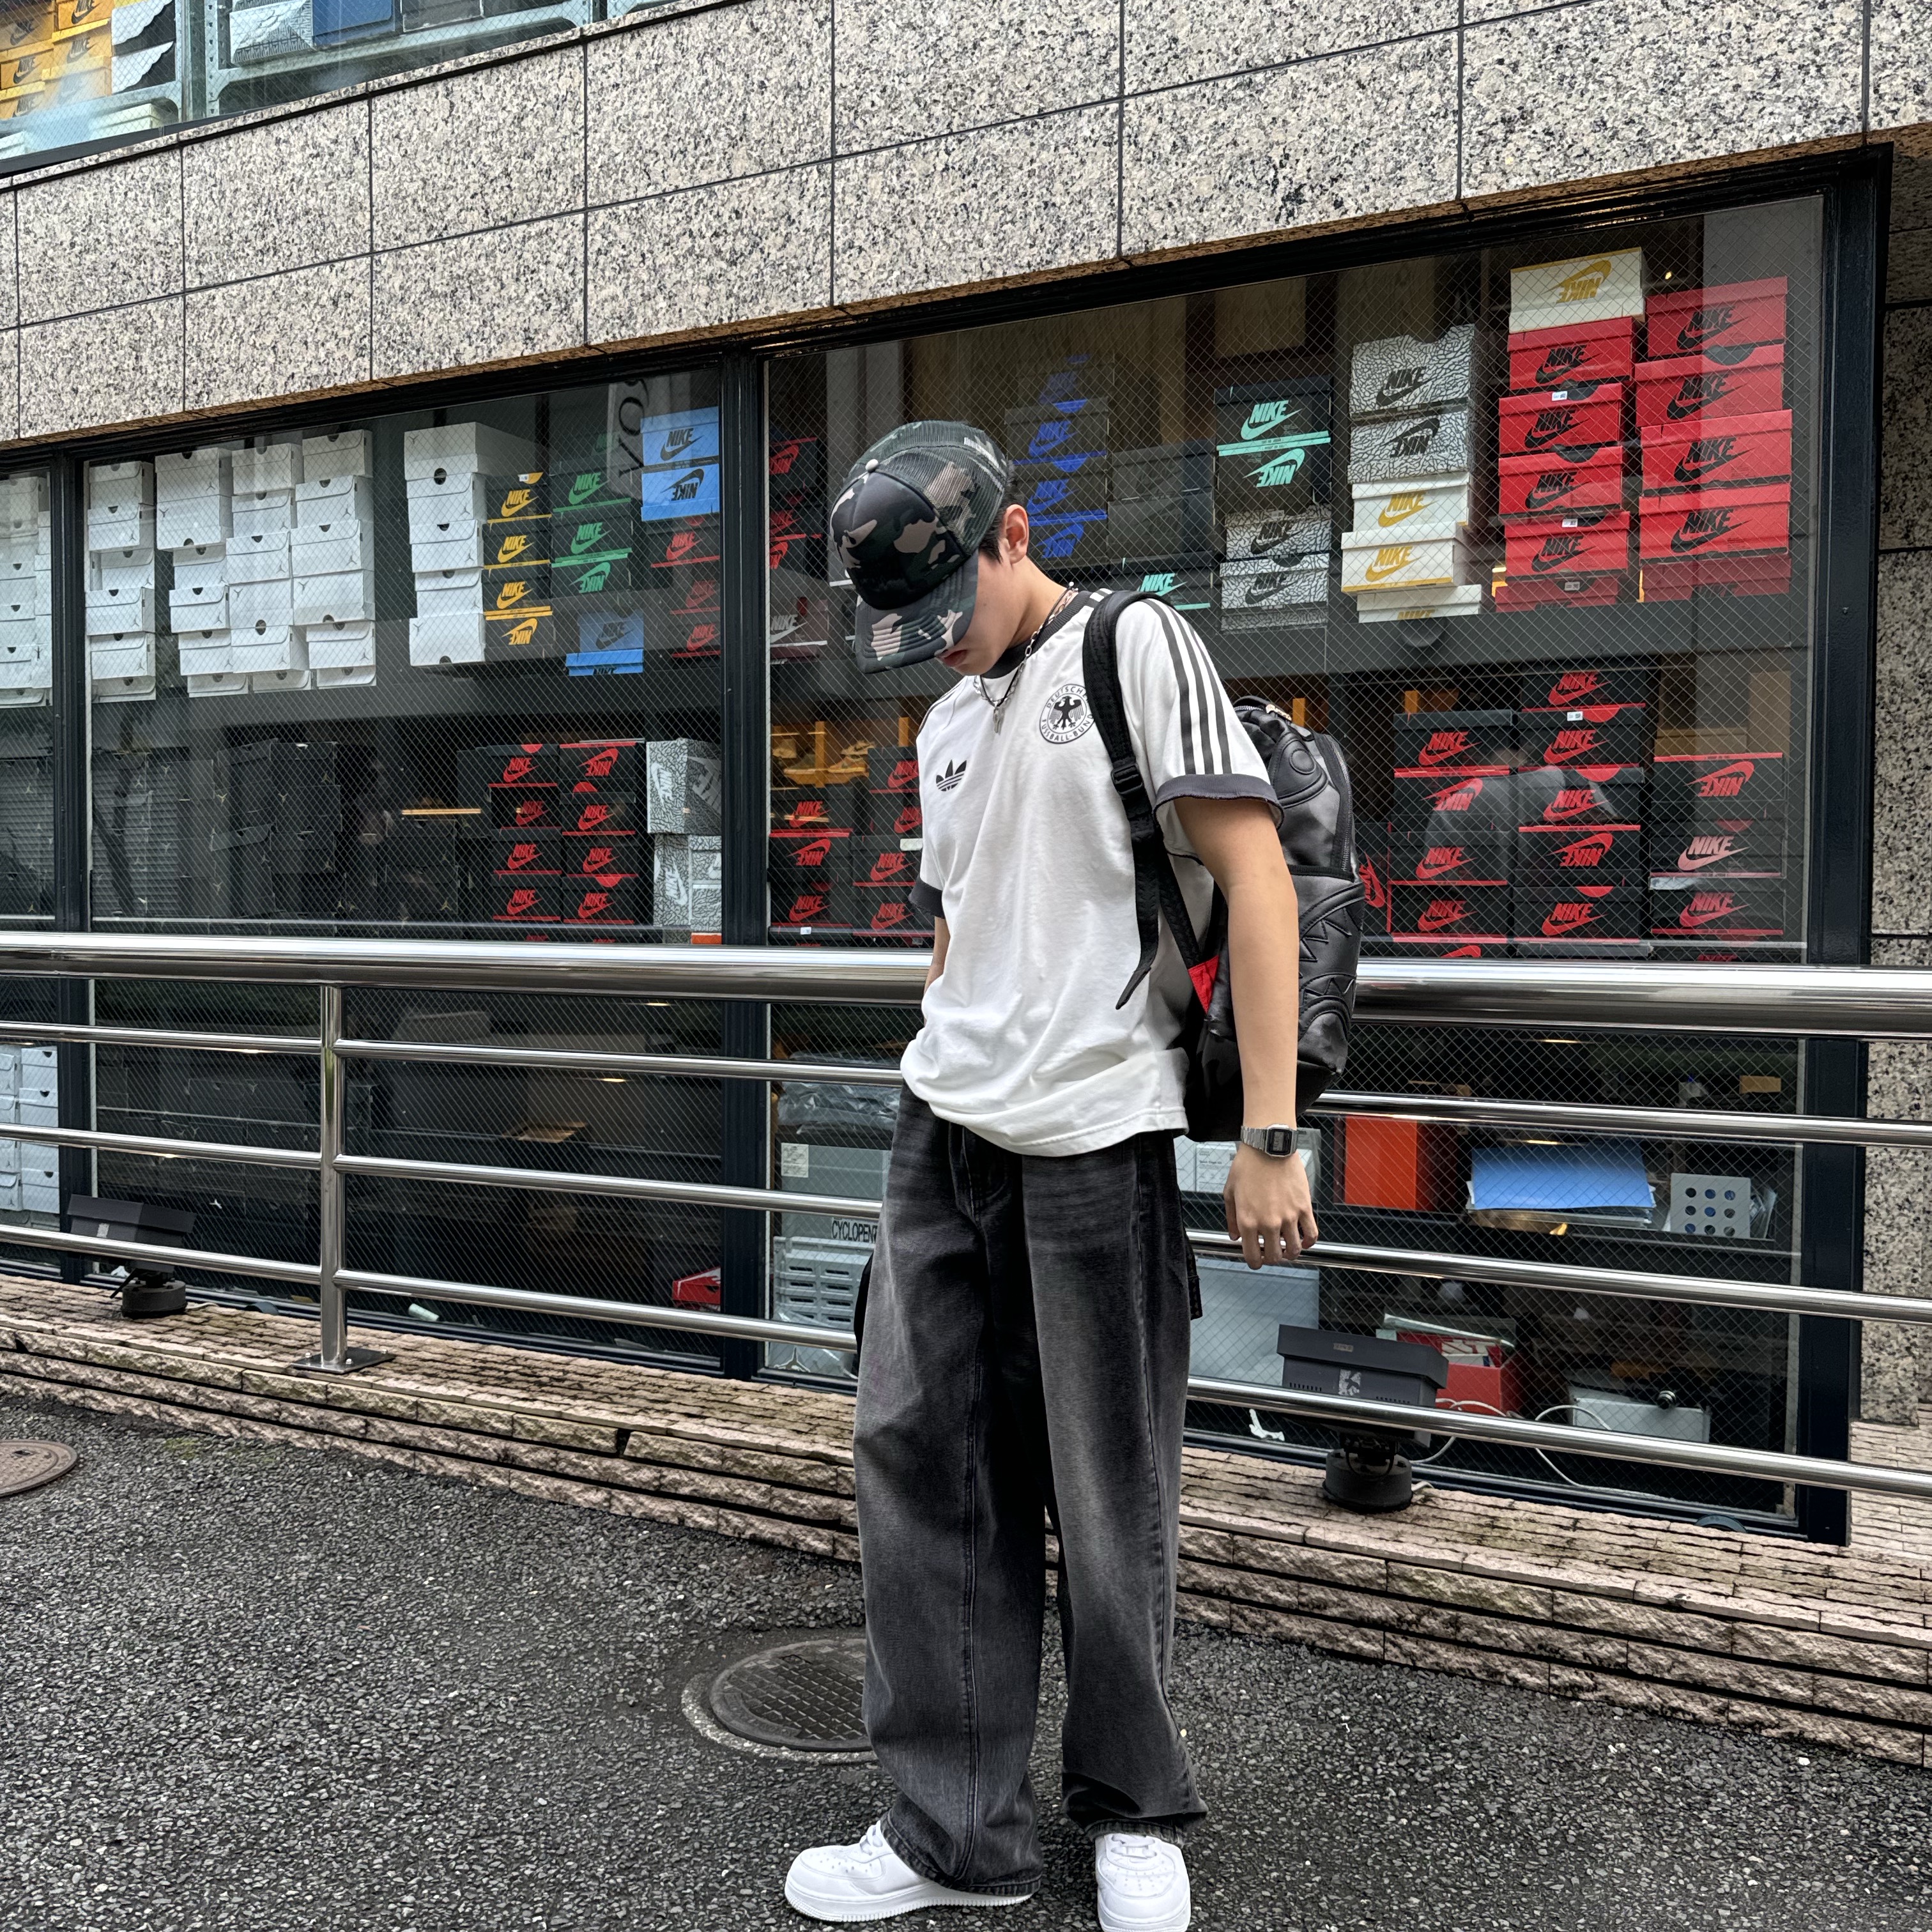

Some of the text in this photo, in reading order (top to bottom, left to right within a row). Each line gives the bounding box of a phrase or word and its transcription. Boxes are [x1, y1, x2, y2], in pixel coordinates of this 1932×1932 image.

[72, 37, 90, 55] NIKE
[1556, 277, 1601, 304] NIKE
[1688, 307, 1733, 330] NIKE
[1544, 345, 1586, 368] NIKE
[1678, 375, 1728, 400] NIKE
[1249, 400, 1289, 424] NIKE
[1535, 410, 1574, 433] NIKE
[666, 428, 694, 447] NIKE
[1686, 438, 1736, 464] NIKE
[575, 472, 601, 494] NIKE
[1256, 464, 1296, 487] NIKE
[1535, 472, 1577, 494] NIKE
[507, 489, 531, 507] NIKE
[671, 481, 699, 501] NIKE
[1388, 491, 1425, 511] NIKE
[1683, 510, 1733, 533] NIKE
[577, 522, 602, 544] NIKE
[673, 532, 696, 549] NIKE
[503, 535, 527, 554] NIKE
[1542, 536, 1583, 556] NIKE
[1375, 546, 1413, 566] NIKE
[502, 581, 525, 600] NIKE
[579, 572, 606, 593] NIKE
[1140, 573, 1175, 592] NIKE
[692, 624, 716, 638] NIKE
[1558, 671, 1597, 691] NIKE
[1427, 732, 1468, 750] NIKE
[1555, 730, 1596, 749] NIKE
[510, 758, 532, 772] NIKE
[1698, 778, 1742, 797] NIKE
[796, 801, 822, 815] NIKE
[1432, 793, 1473, 811] NIKE
[1554, 790, 1596, 808] NIKE
[583, 805, 608, 822] NIKE
[513, 844, 537, 859] NIKE
[1689, 836, 1733, 854] NIKE
[588, 848, 613, 862] NIKE
[878, 854, 905, 868] NIKE
[1424, 848, 1464, 864] NIKE
[1561, 848, 1602, 866] NIKE
[512, 890, 536, 906] NIKE
[583, 893, 608, 908] NIKE
[796, 896, 822, 909] NIKE
[1690, 893, 1735, 910] NIKE
[878, 903, 905, 918] NIKE
[1427, 900, 1466, 917] NIKE
[1551, 903, 1593, 921] NIKE
